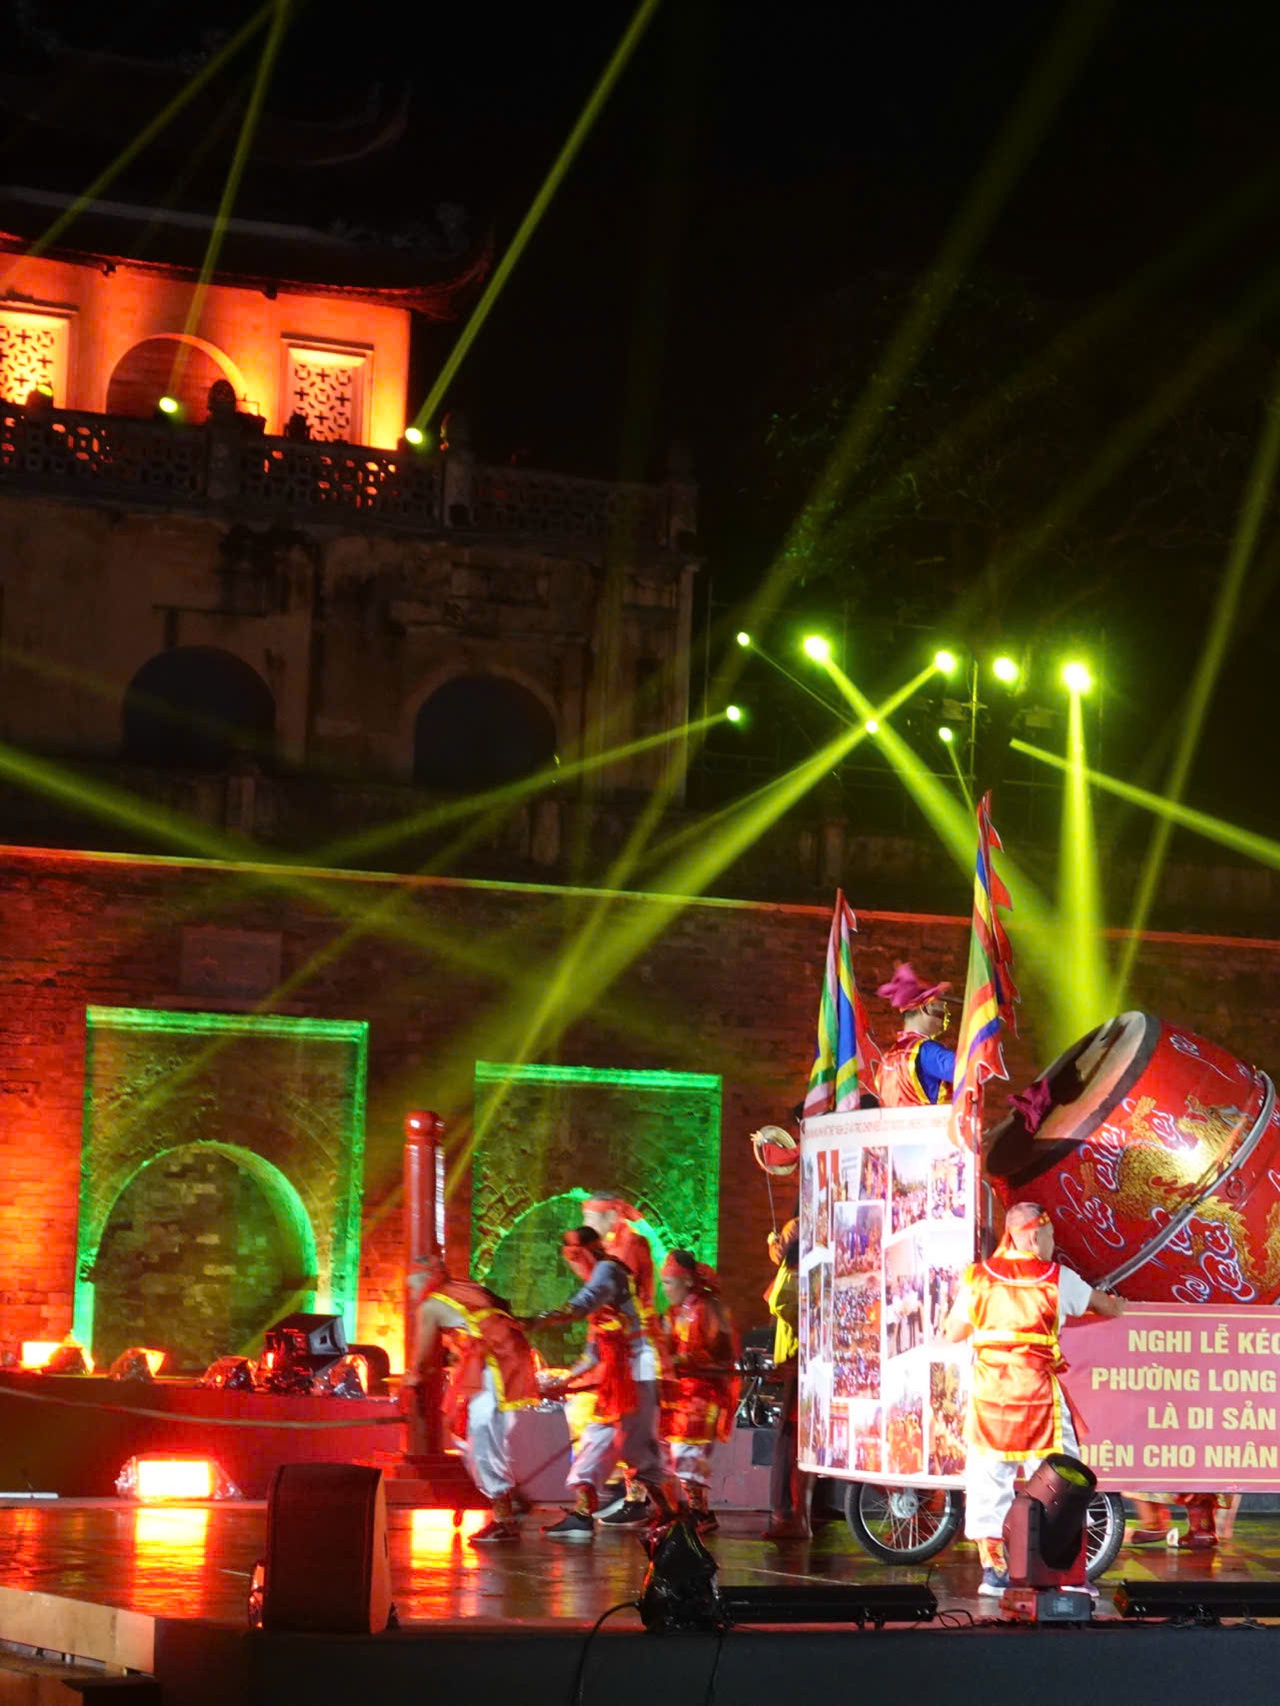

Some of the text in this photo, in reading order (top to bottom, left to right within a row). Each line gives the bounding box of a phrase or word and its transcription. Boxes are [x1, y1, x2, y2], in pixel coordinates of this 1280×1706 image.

[1128, 1330, 1191, 1353] NGHI
[1200, 1323, 1229, 1354] LỄ
[1091, 1363, 1200, 1391] PHƯỜNG
[1208, 1369, 1276, 1392] LONG
[1147, 1402, 1179, 1429] LÀ
[1187, 1407, 1213, 1429] DI
[1222, 1401, 1276, 1430] SẢN
[1143, 1445, 1196, 1468] CHO
[1205, 1442, 1278, 1469] NHÂN
